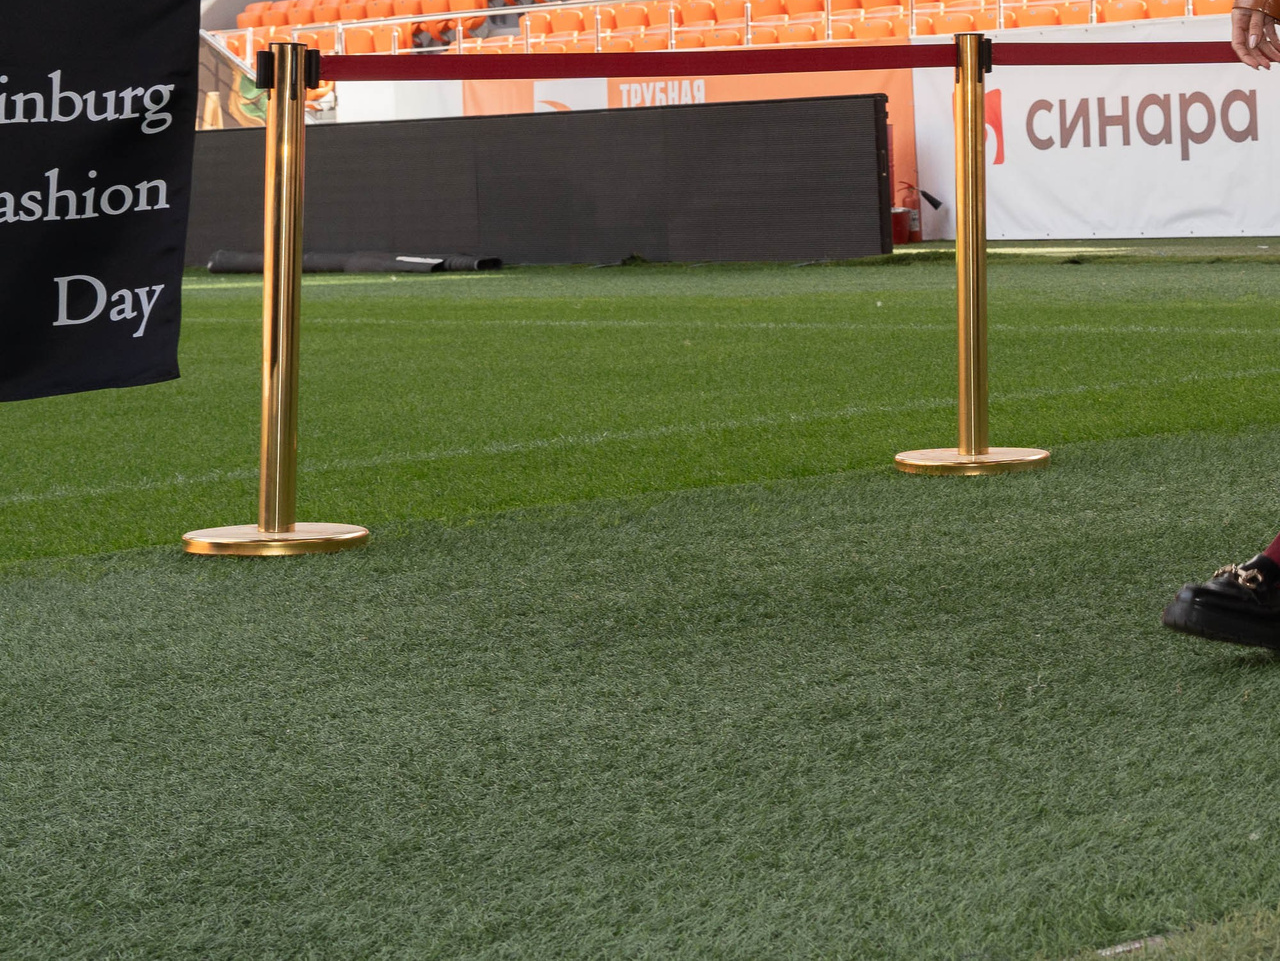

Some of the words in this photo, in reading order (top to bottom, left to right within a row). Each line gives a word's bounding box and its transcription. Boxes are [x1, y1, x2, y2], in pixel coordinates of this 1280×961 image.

[0, 69, 175, 135] inburg
[619, 78, 705, 108] ТРУБНАЯ
[1025, 89, 1259, 161] синара
[0, 167, 170, 223] ashion
[52, 274, 165, 338] Day
